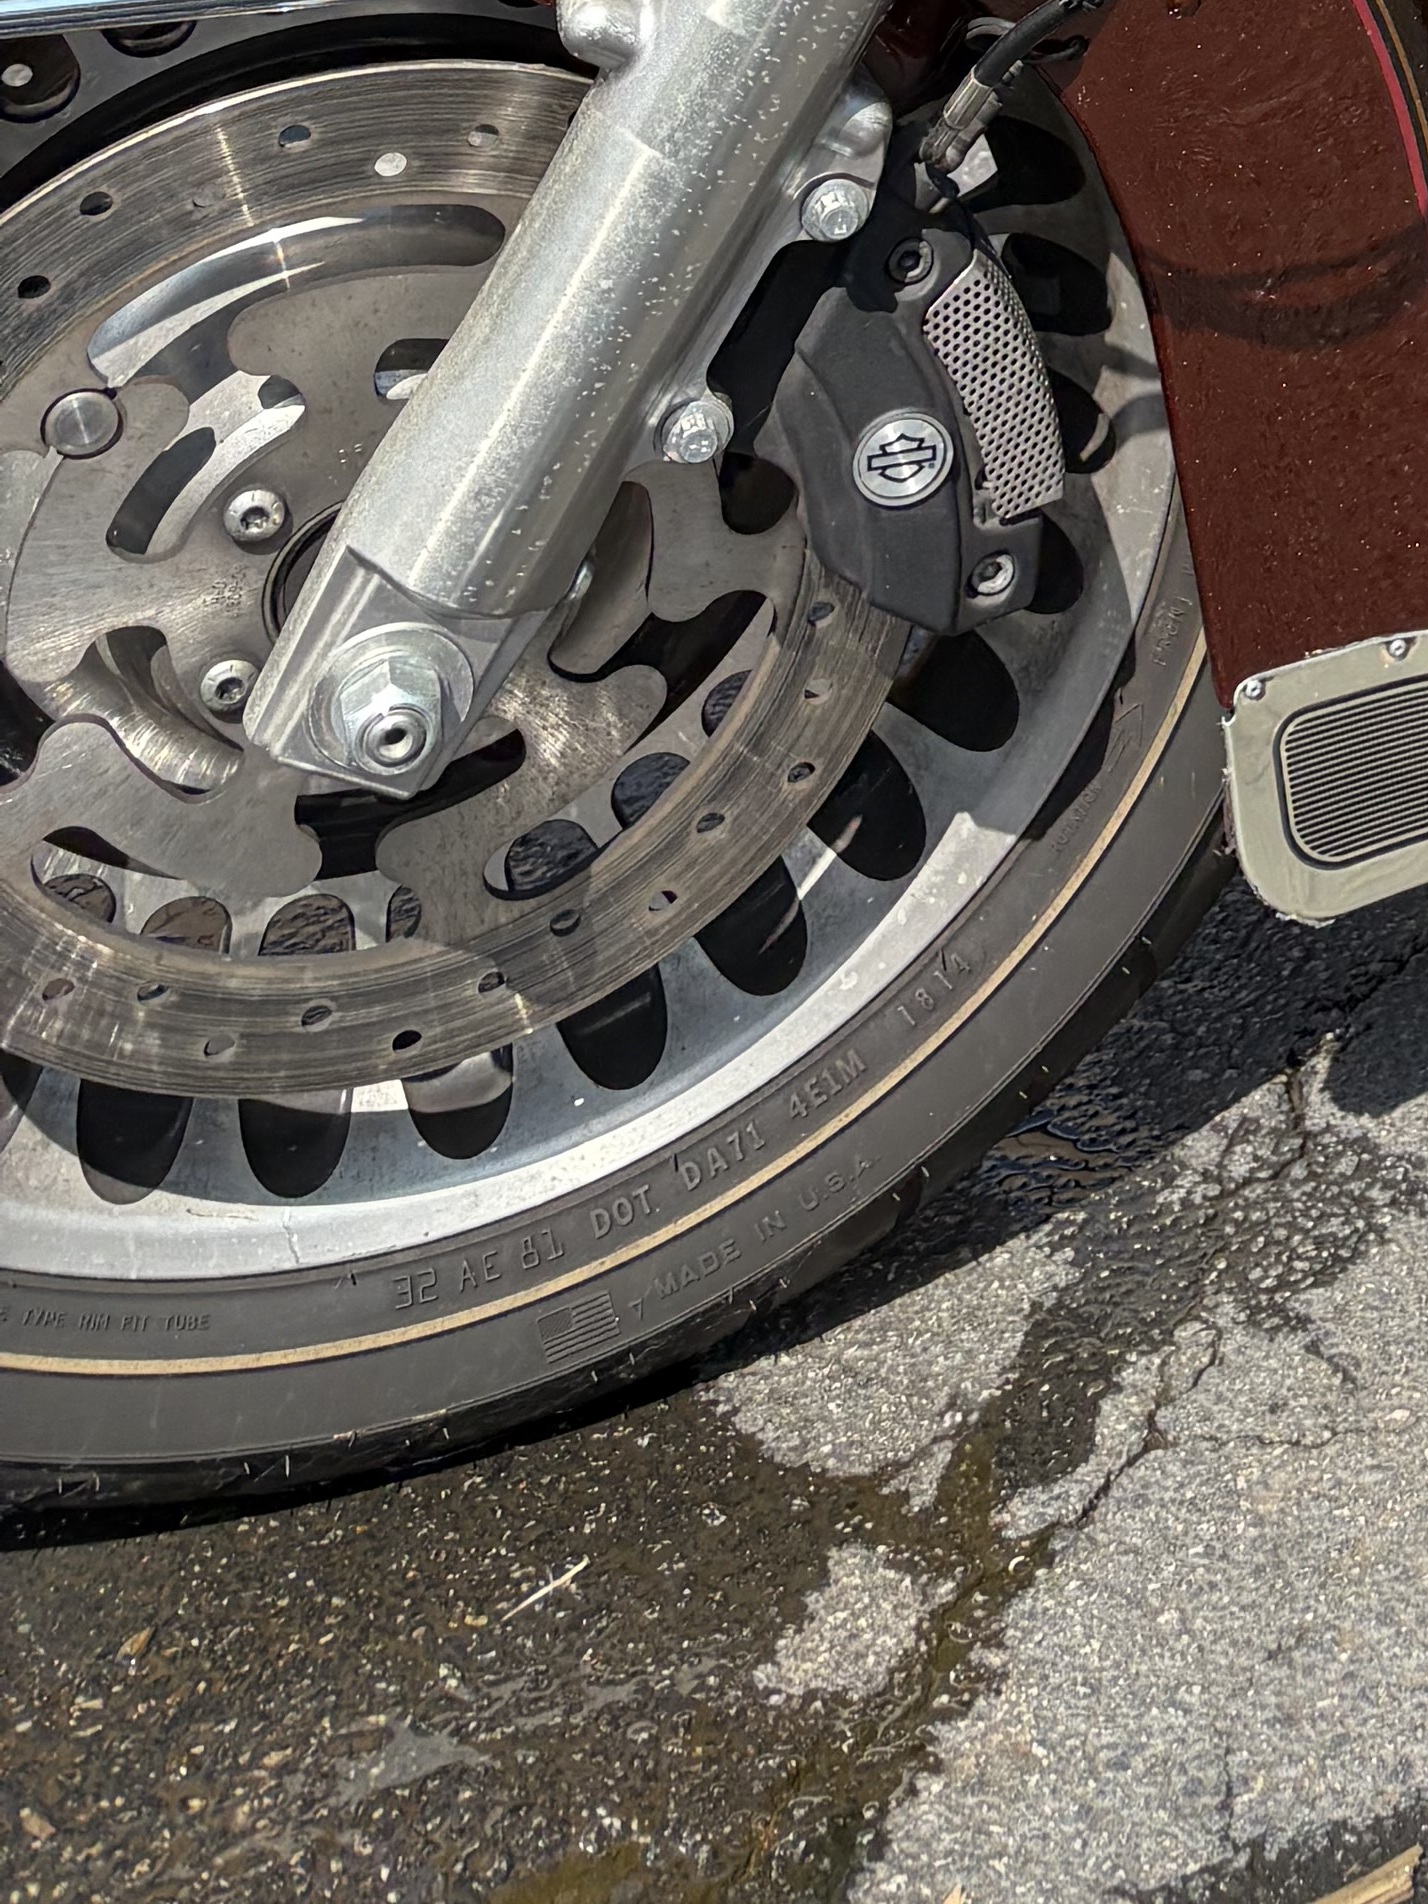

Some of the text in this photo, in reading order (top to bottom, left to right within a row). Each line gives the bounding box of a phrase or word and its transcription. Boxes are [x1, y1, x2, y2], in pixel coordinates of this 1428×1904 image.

[588, 1183, 652, 1240] DOT
[676, 1118, 766, 1192] DA71
[651, 1237, 742, 1299] MADE
[753, 1209, 786, 1242] IN
[163, 1312, 212, 1332] TUBE
